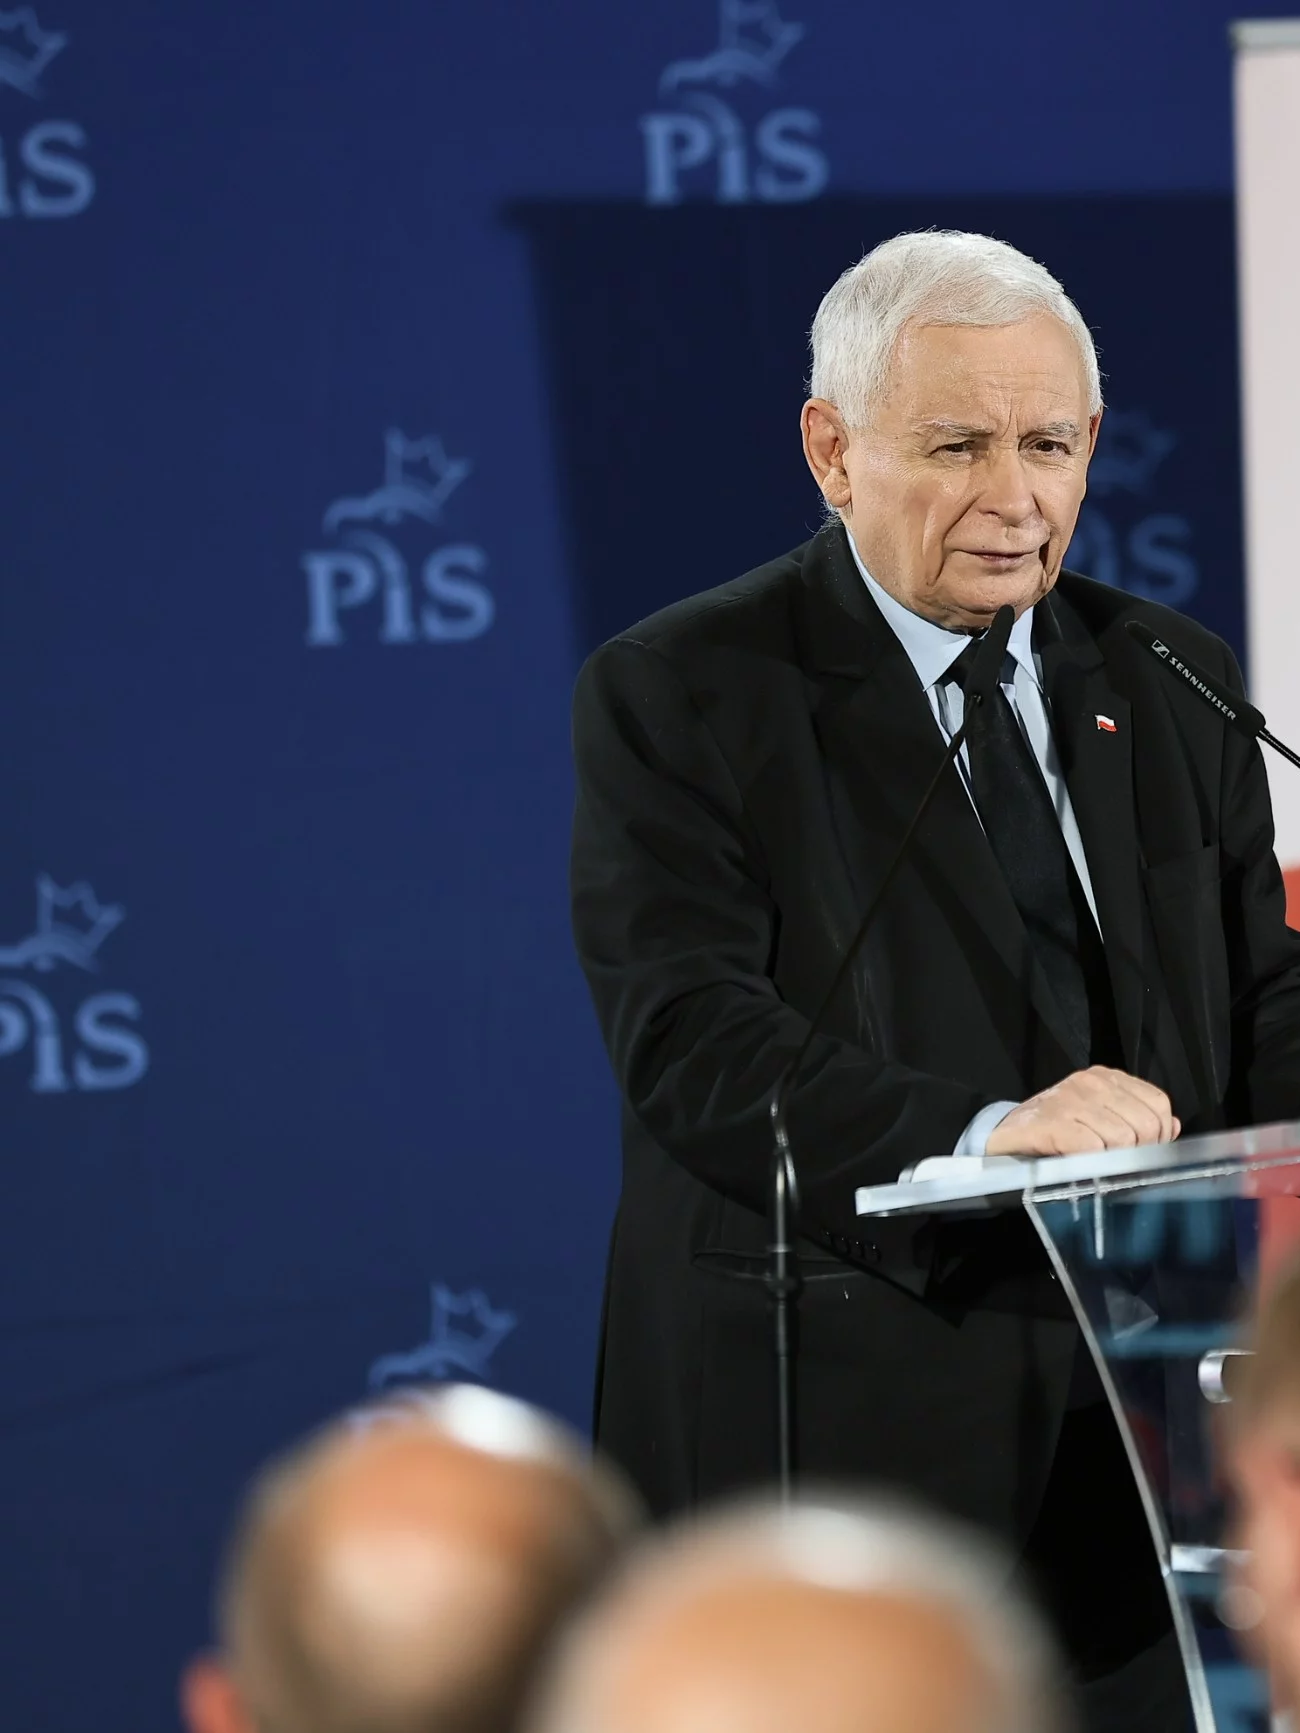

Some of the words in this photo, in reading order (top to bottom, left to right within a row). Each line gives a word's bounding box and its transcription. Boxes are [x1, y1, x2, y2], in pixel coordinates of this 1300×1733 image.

[640, 100, 829, 206] PiS
[304, 532, 494, 648] PiS
[1169, 656, 1237, 720] SENNHEISER
